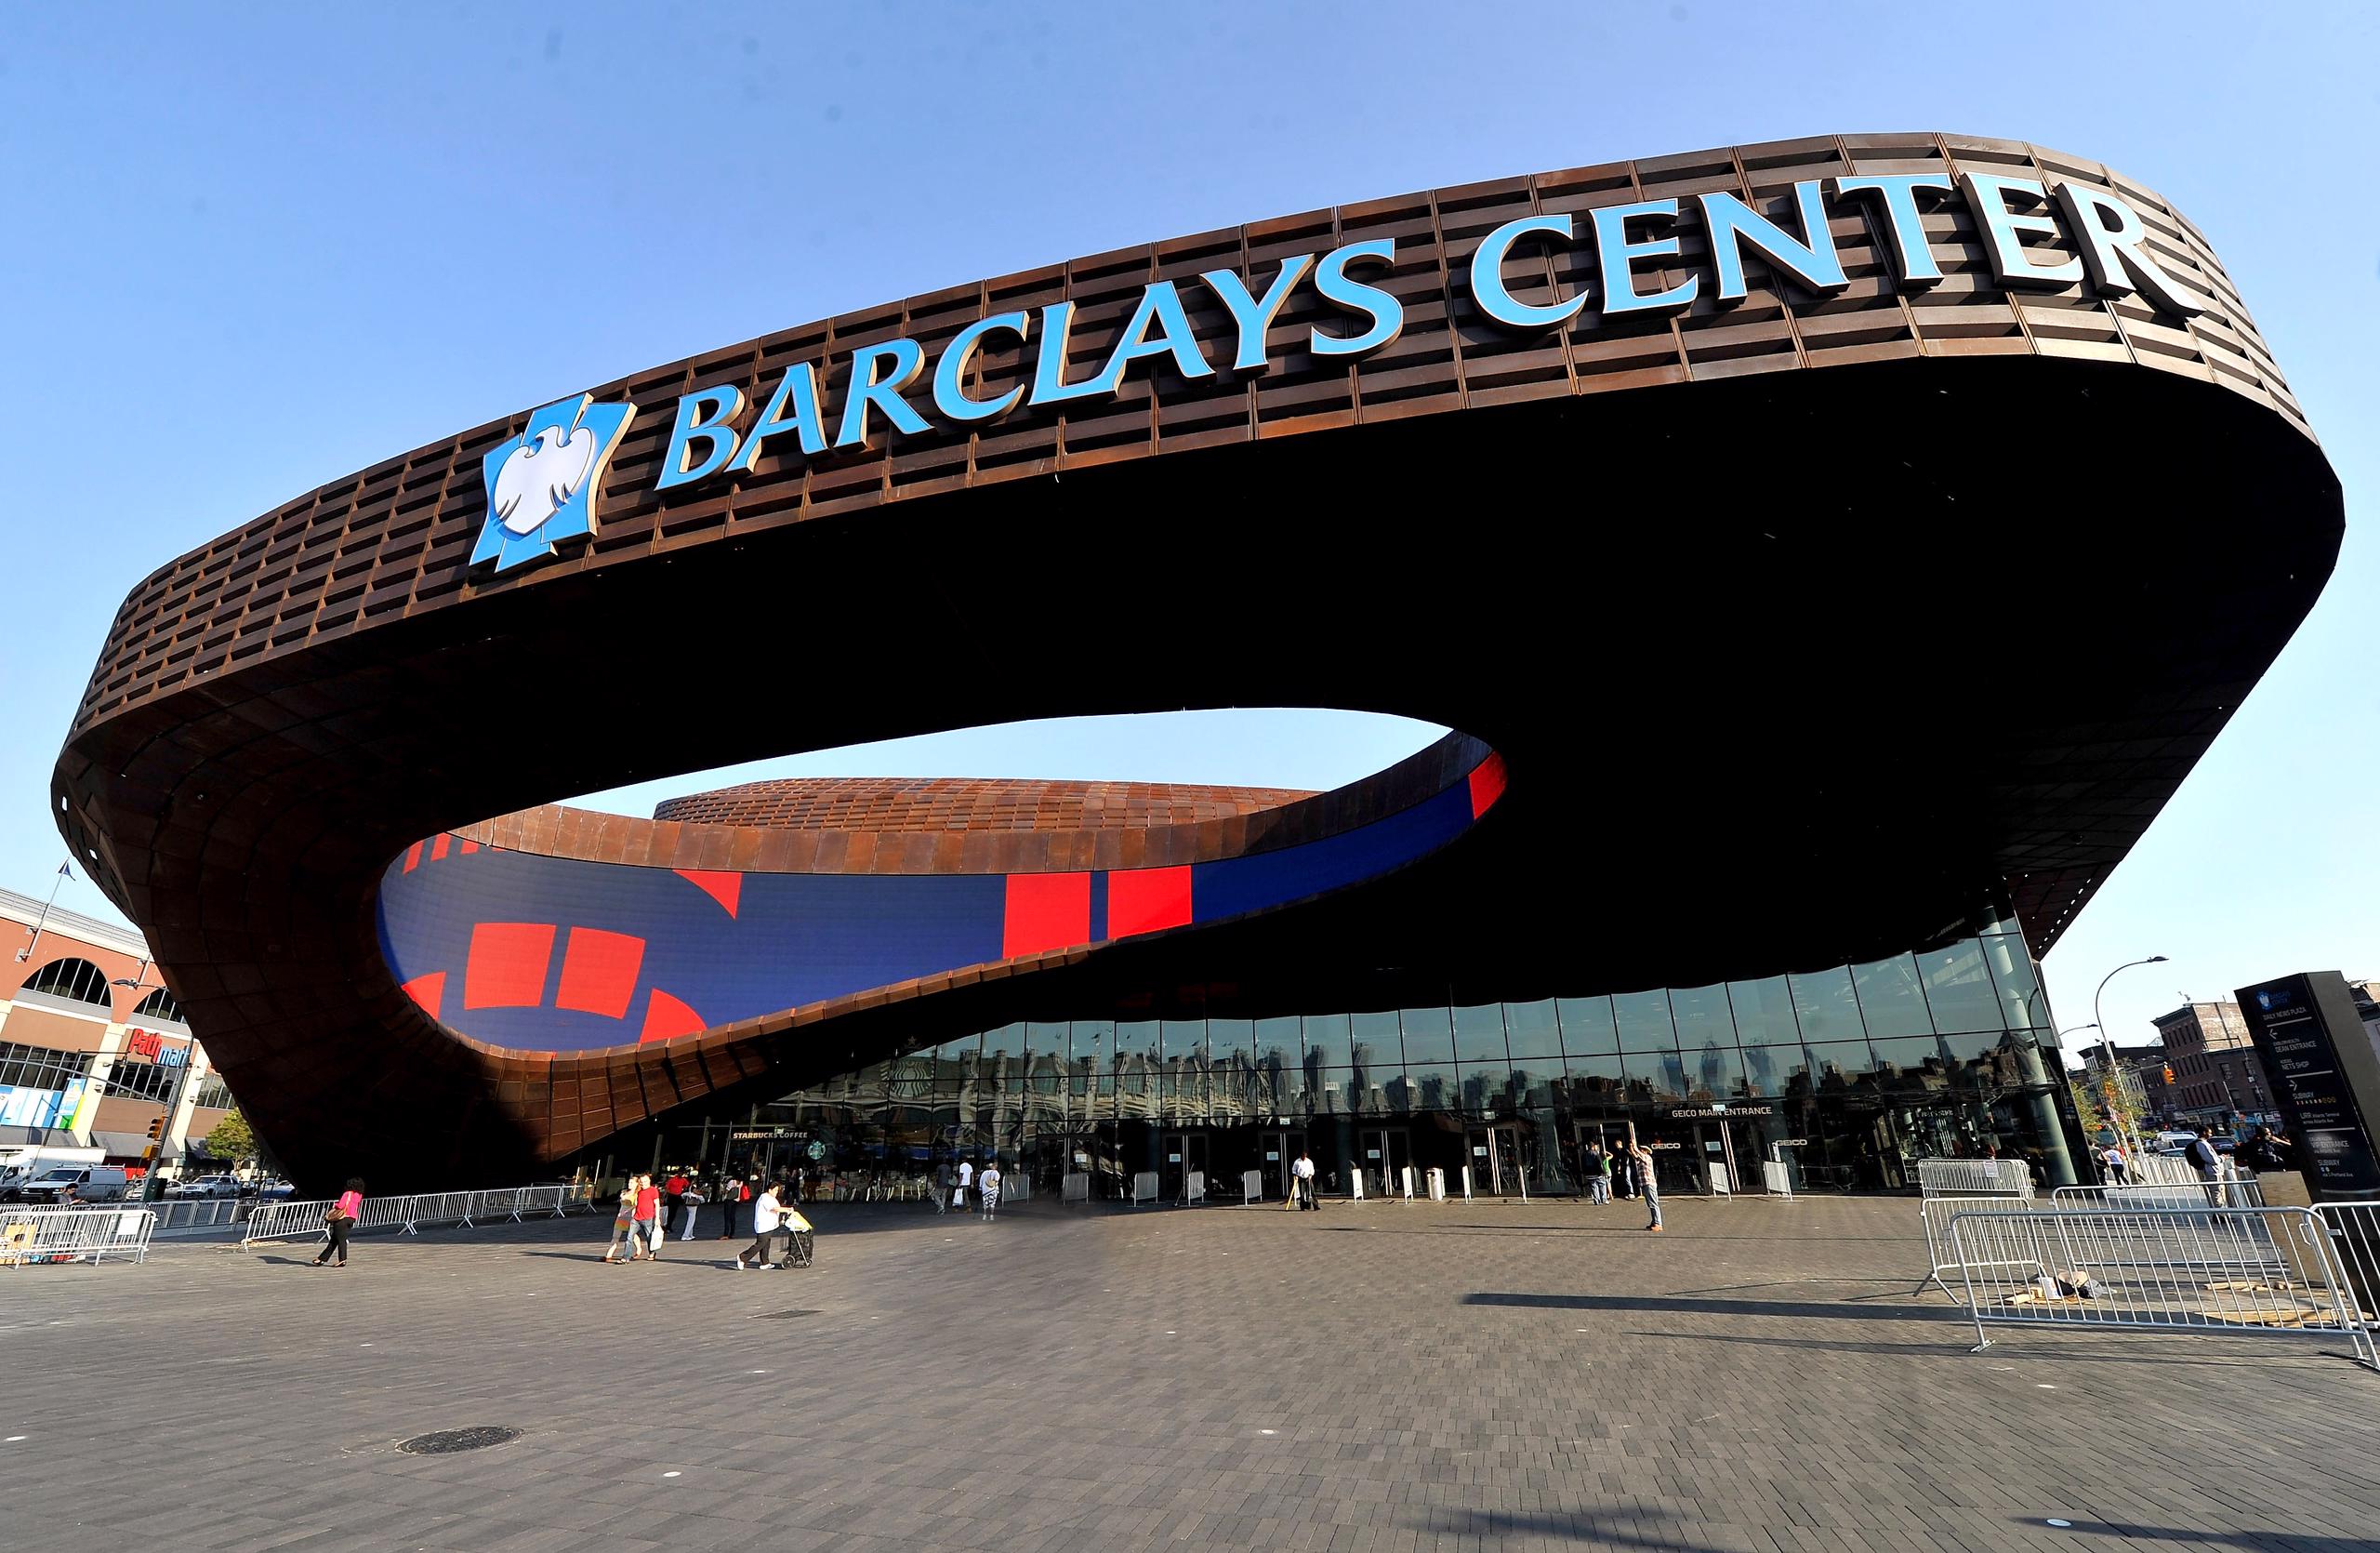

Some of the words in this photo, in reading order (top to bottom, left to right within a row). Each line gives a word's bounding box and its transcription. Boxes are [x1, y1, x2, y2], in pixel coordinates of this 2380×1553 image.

[654, 238, 1404, 493] BARCLAYS
[1471, 171, 2207, 329] CENTER
[1672, 1109, 1697, 1118] GEICO
[1699, 1108, 1723, 1117] MAIN
[1724, 1107, 1773, 1116] ENTRANCE
